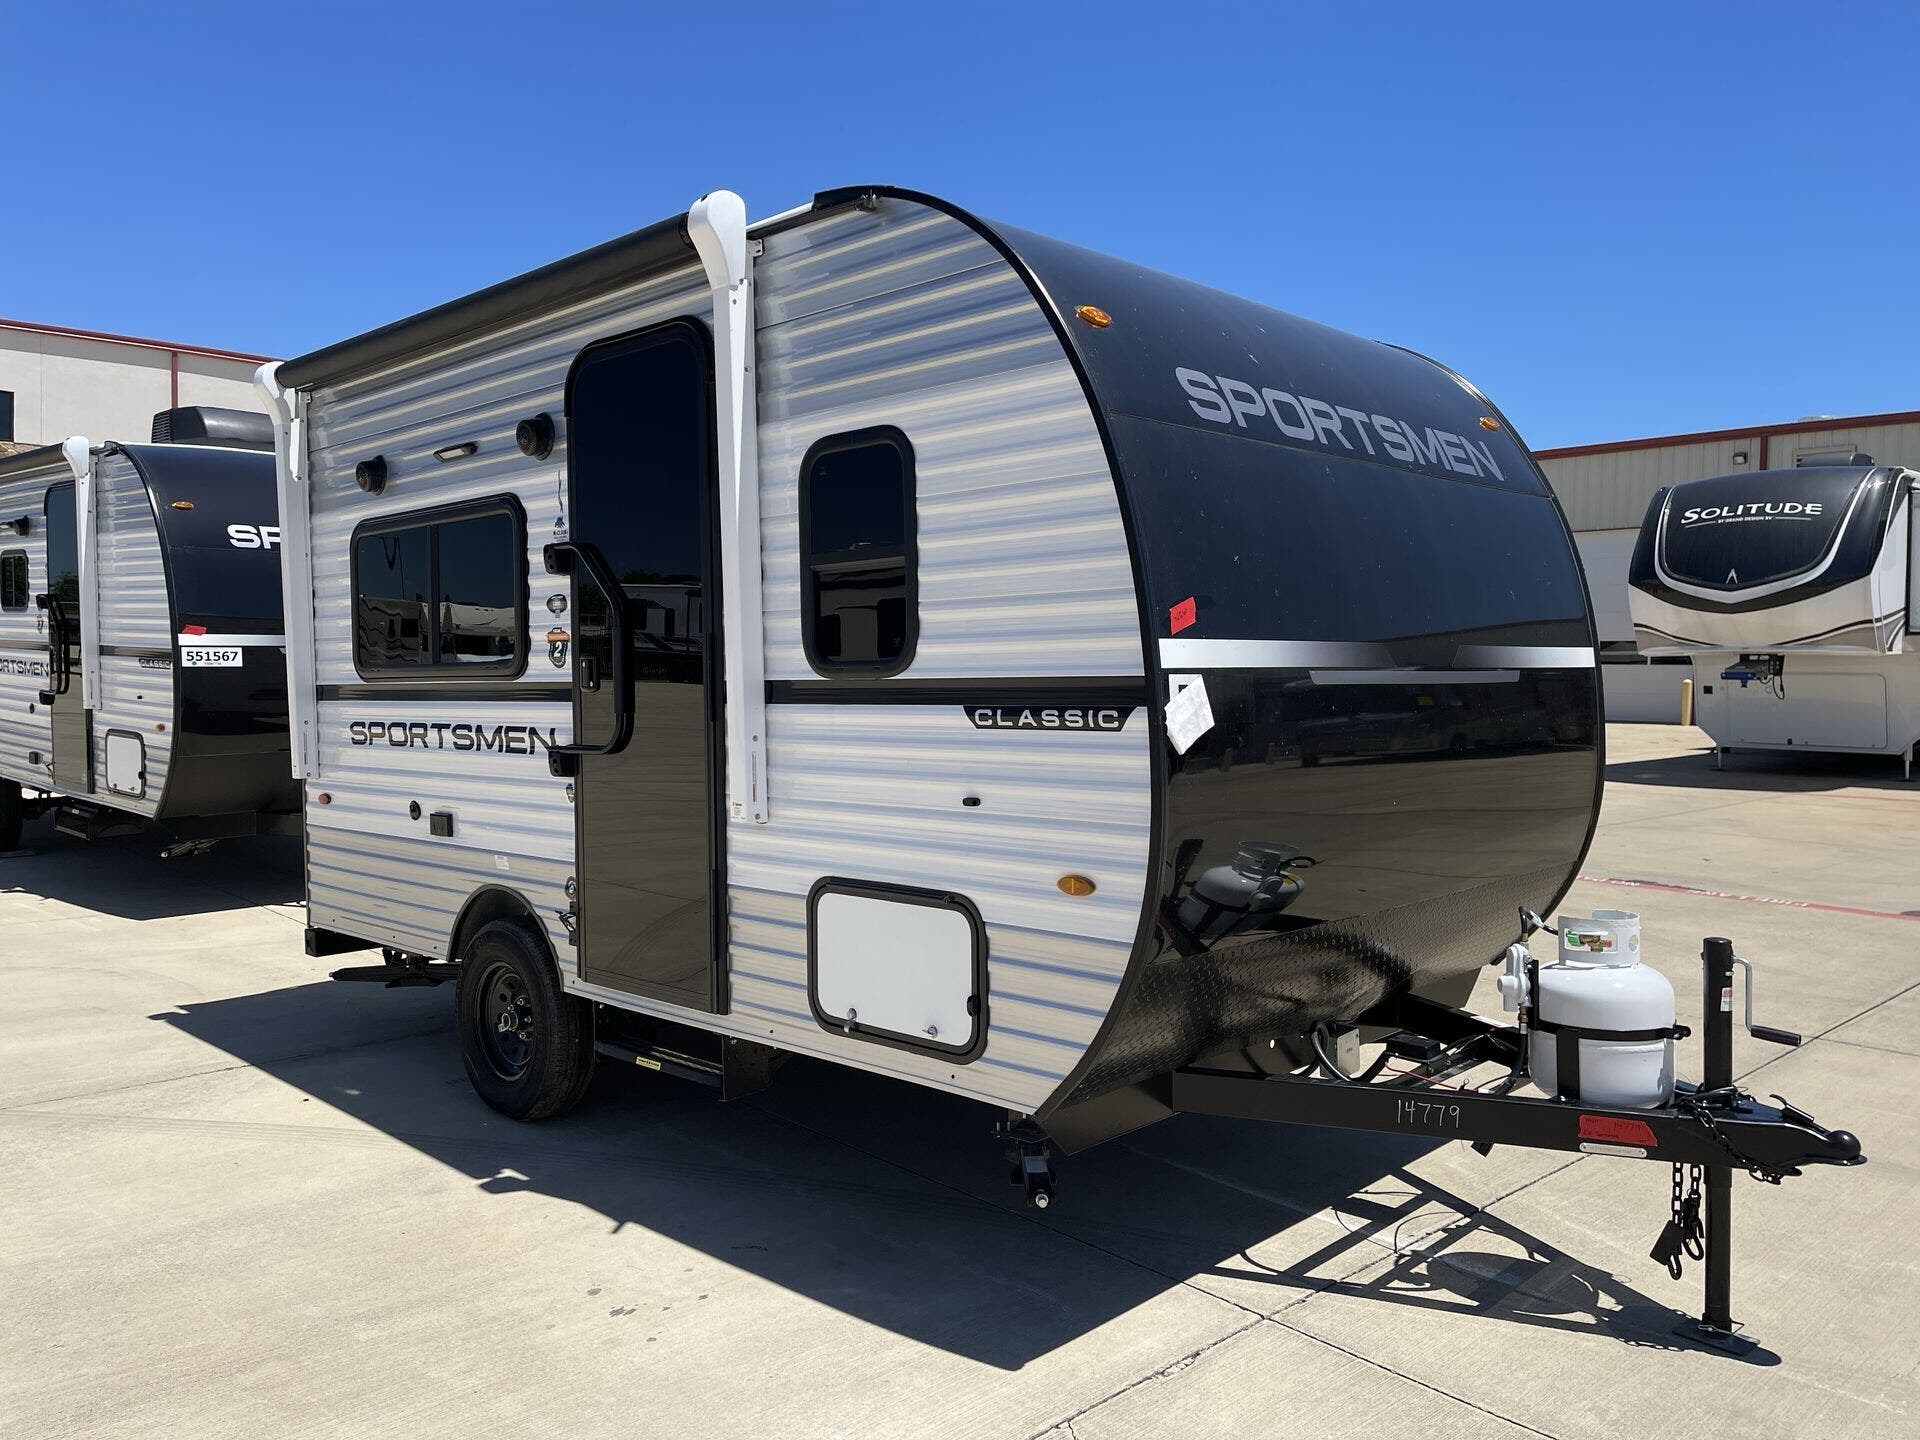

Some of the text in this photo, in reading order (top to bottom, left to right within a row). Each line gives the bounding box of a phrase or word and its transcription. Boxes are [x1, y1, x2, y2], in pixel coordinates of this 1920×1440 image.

[1175, 367, 1504, 481] SPORTSMEN
[1681, 502, 1822, 524] SOLITUDE
[186, 651, 239, 662] 551567
[974, 709, 1120, 728] CLASSIC
[350, 721, 556, 755] SPORTSMEN
[1397, 1099, 1460, 1129] 14779
